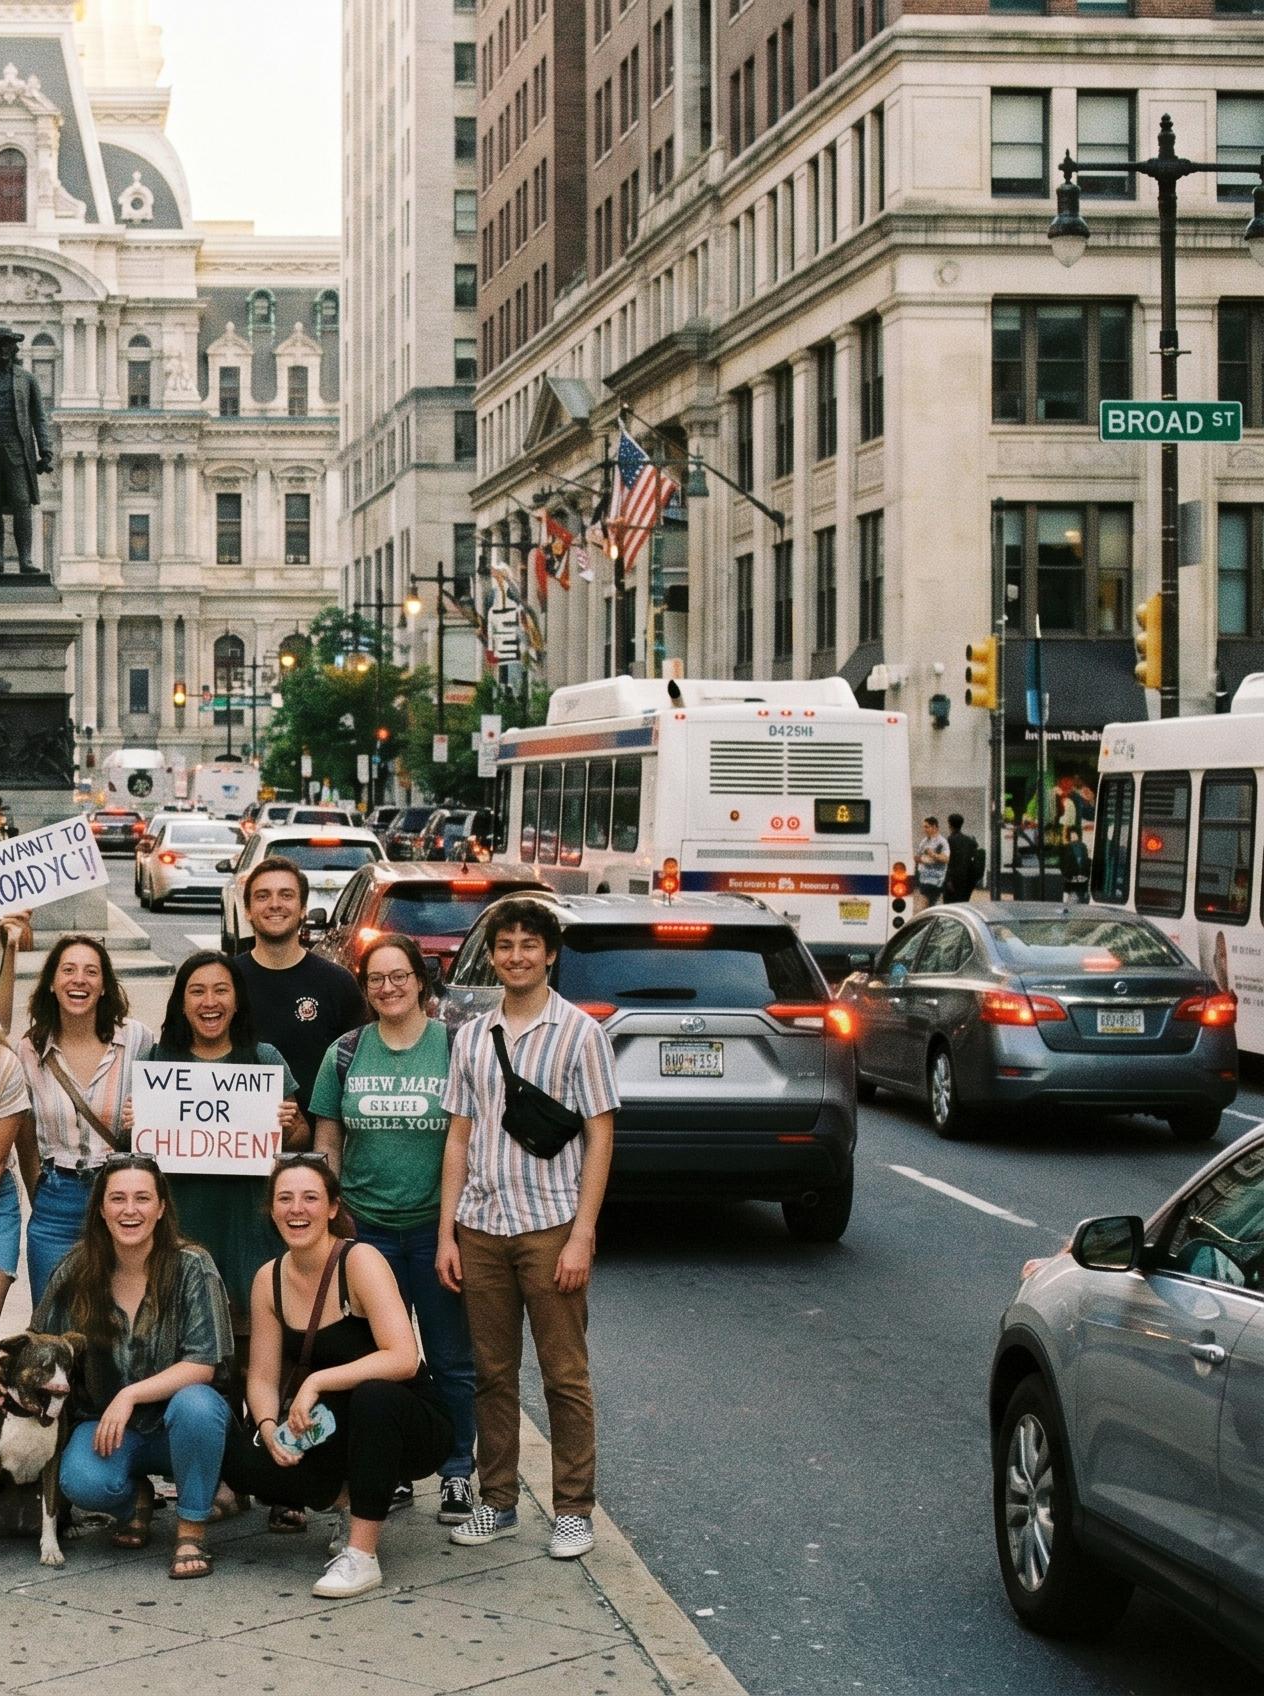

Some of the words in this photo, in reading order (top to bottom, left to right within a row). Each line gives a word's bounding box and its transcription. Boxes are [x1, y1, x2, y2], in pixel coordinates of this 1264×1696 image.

[1108, 409, 1203, 434] BROAD
[1212, 411, 1235, 427] ST
[60, 822, 86, 845] TO
[144, 1068, 192, 1091] WE
[211, 1071, 275, 1092] WANT
[179, 1100, 230, 1122] FOR
